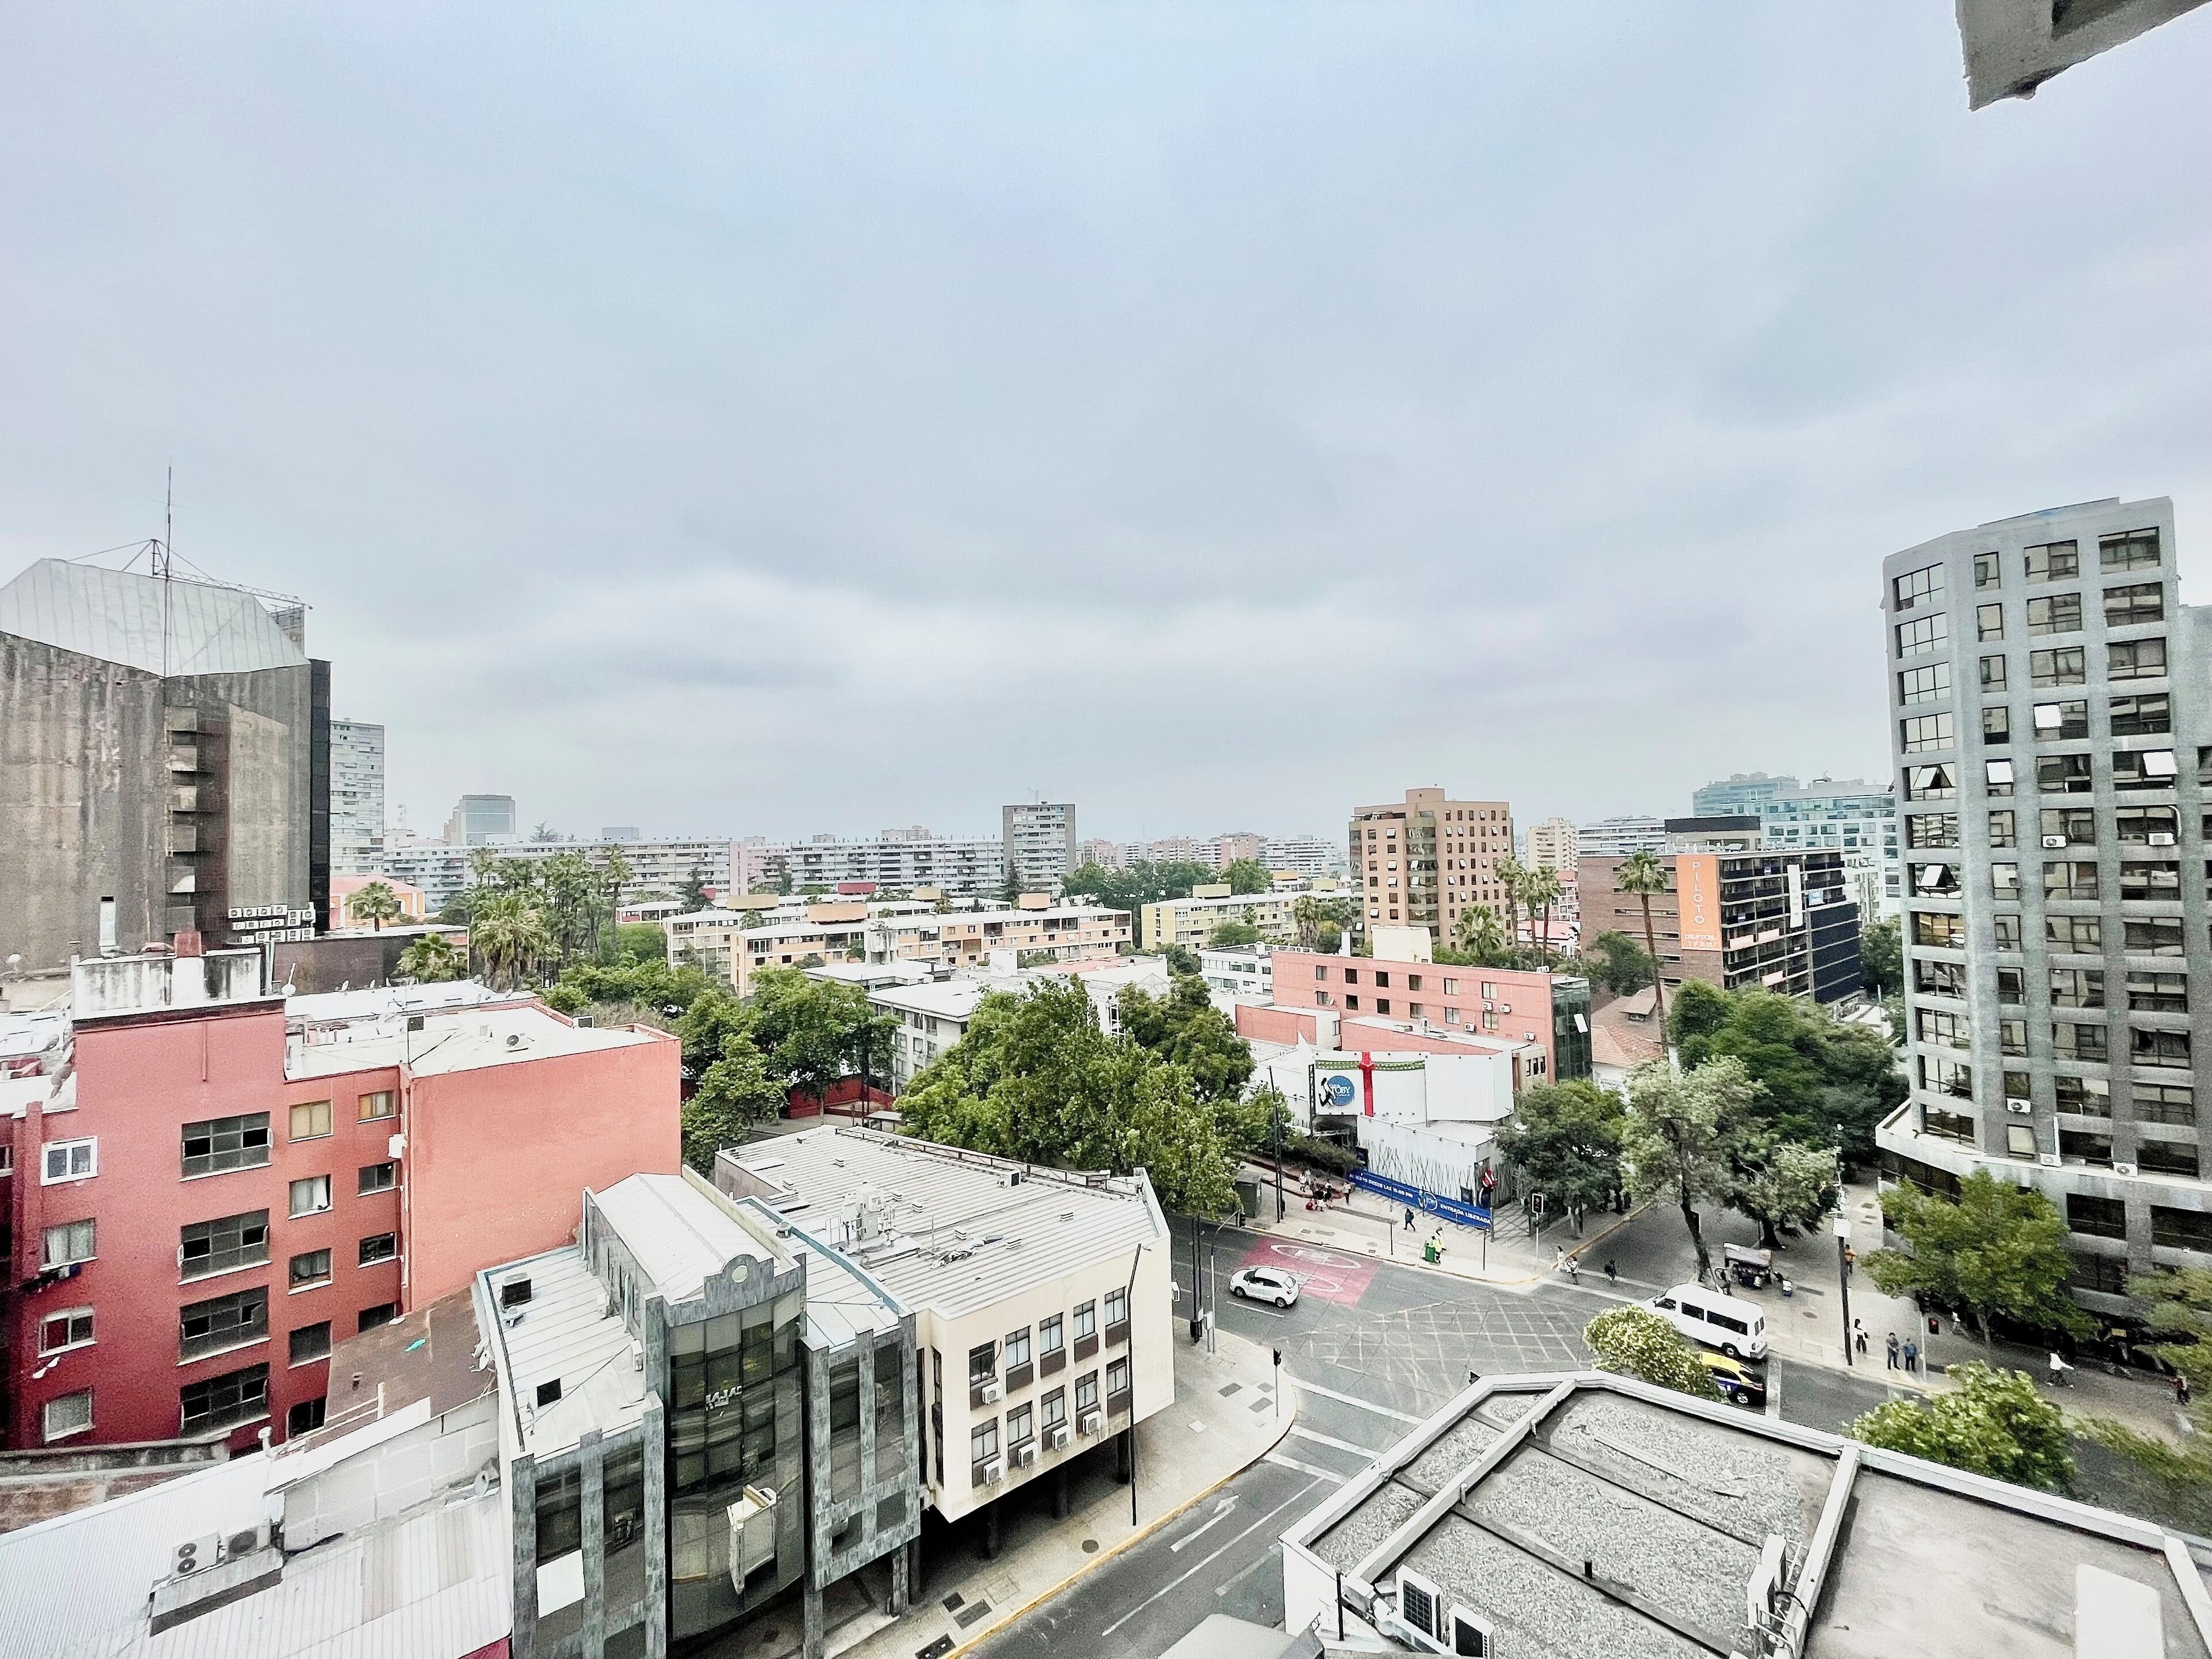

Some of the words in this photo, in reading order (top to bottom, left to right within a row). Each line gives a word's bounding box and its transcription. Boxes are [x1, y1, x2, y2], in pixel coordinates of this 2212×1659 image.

[1692, 862, 1705, 925] PILOTO
[1331, 1086, 1351, 1094] TOBY
[1440, 1203, 1464, 1215] ENTRADA
[1465, 1212, 1491, 1224] LIBERADA
